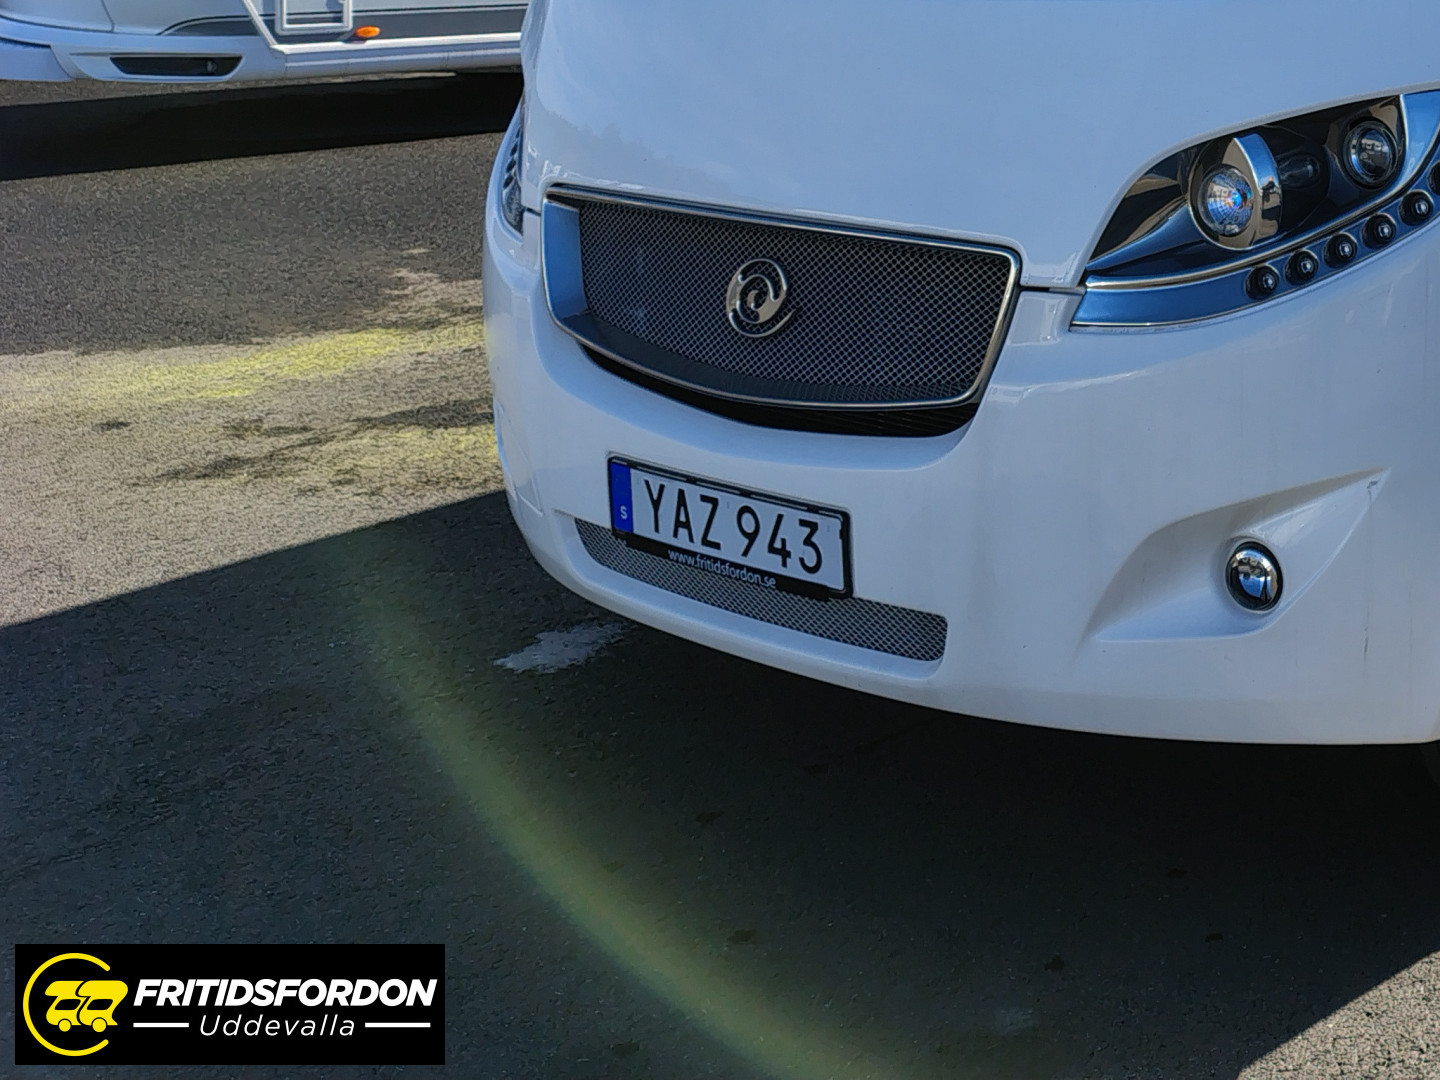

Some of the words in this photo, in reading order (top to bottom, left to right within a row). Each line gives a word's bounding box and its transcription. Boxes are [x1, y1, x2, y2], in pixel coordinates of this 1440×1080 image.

[620, 505, 628, 520] S
[643, 479, 721, 551] YAZ
[736, 504, 822, 574] 943
[668, 549, 777, 588] www.fritidsfordon.se
